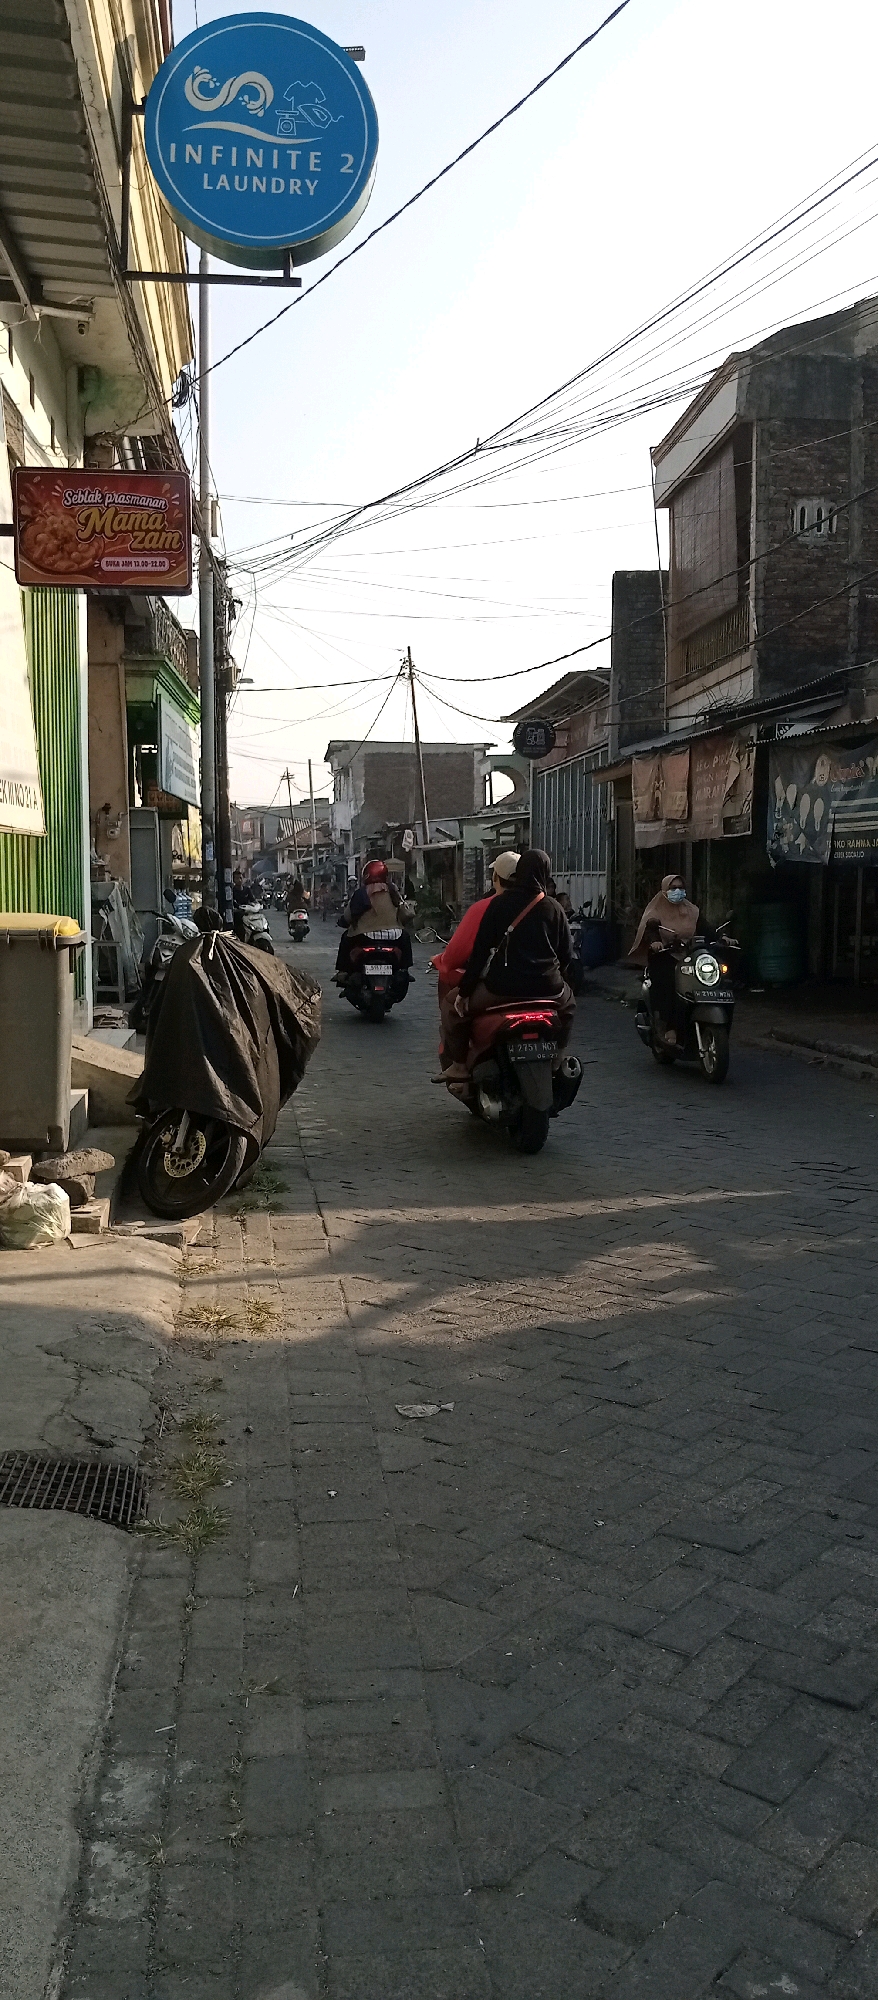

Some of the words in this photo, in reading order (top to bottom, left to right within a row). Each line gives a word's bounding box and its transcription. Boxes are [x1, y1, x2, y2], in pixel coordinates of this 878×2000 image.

[169, 143, 322, 172] INFINITE
[339, 153, 355, 174] 2
[203, 173, 319, 196] LAUNDRY
[64, 489, 103, 505] Seblak
[104, 492, 167, 509] prasmanan
[77, 506, 164, 539] Mama
[130, 530, 181, 550] zam
[105, 560, 120, 568] BUKA
[121, 560, 132, 568] JAM
[847, 838, 871, 848] RAHMA
